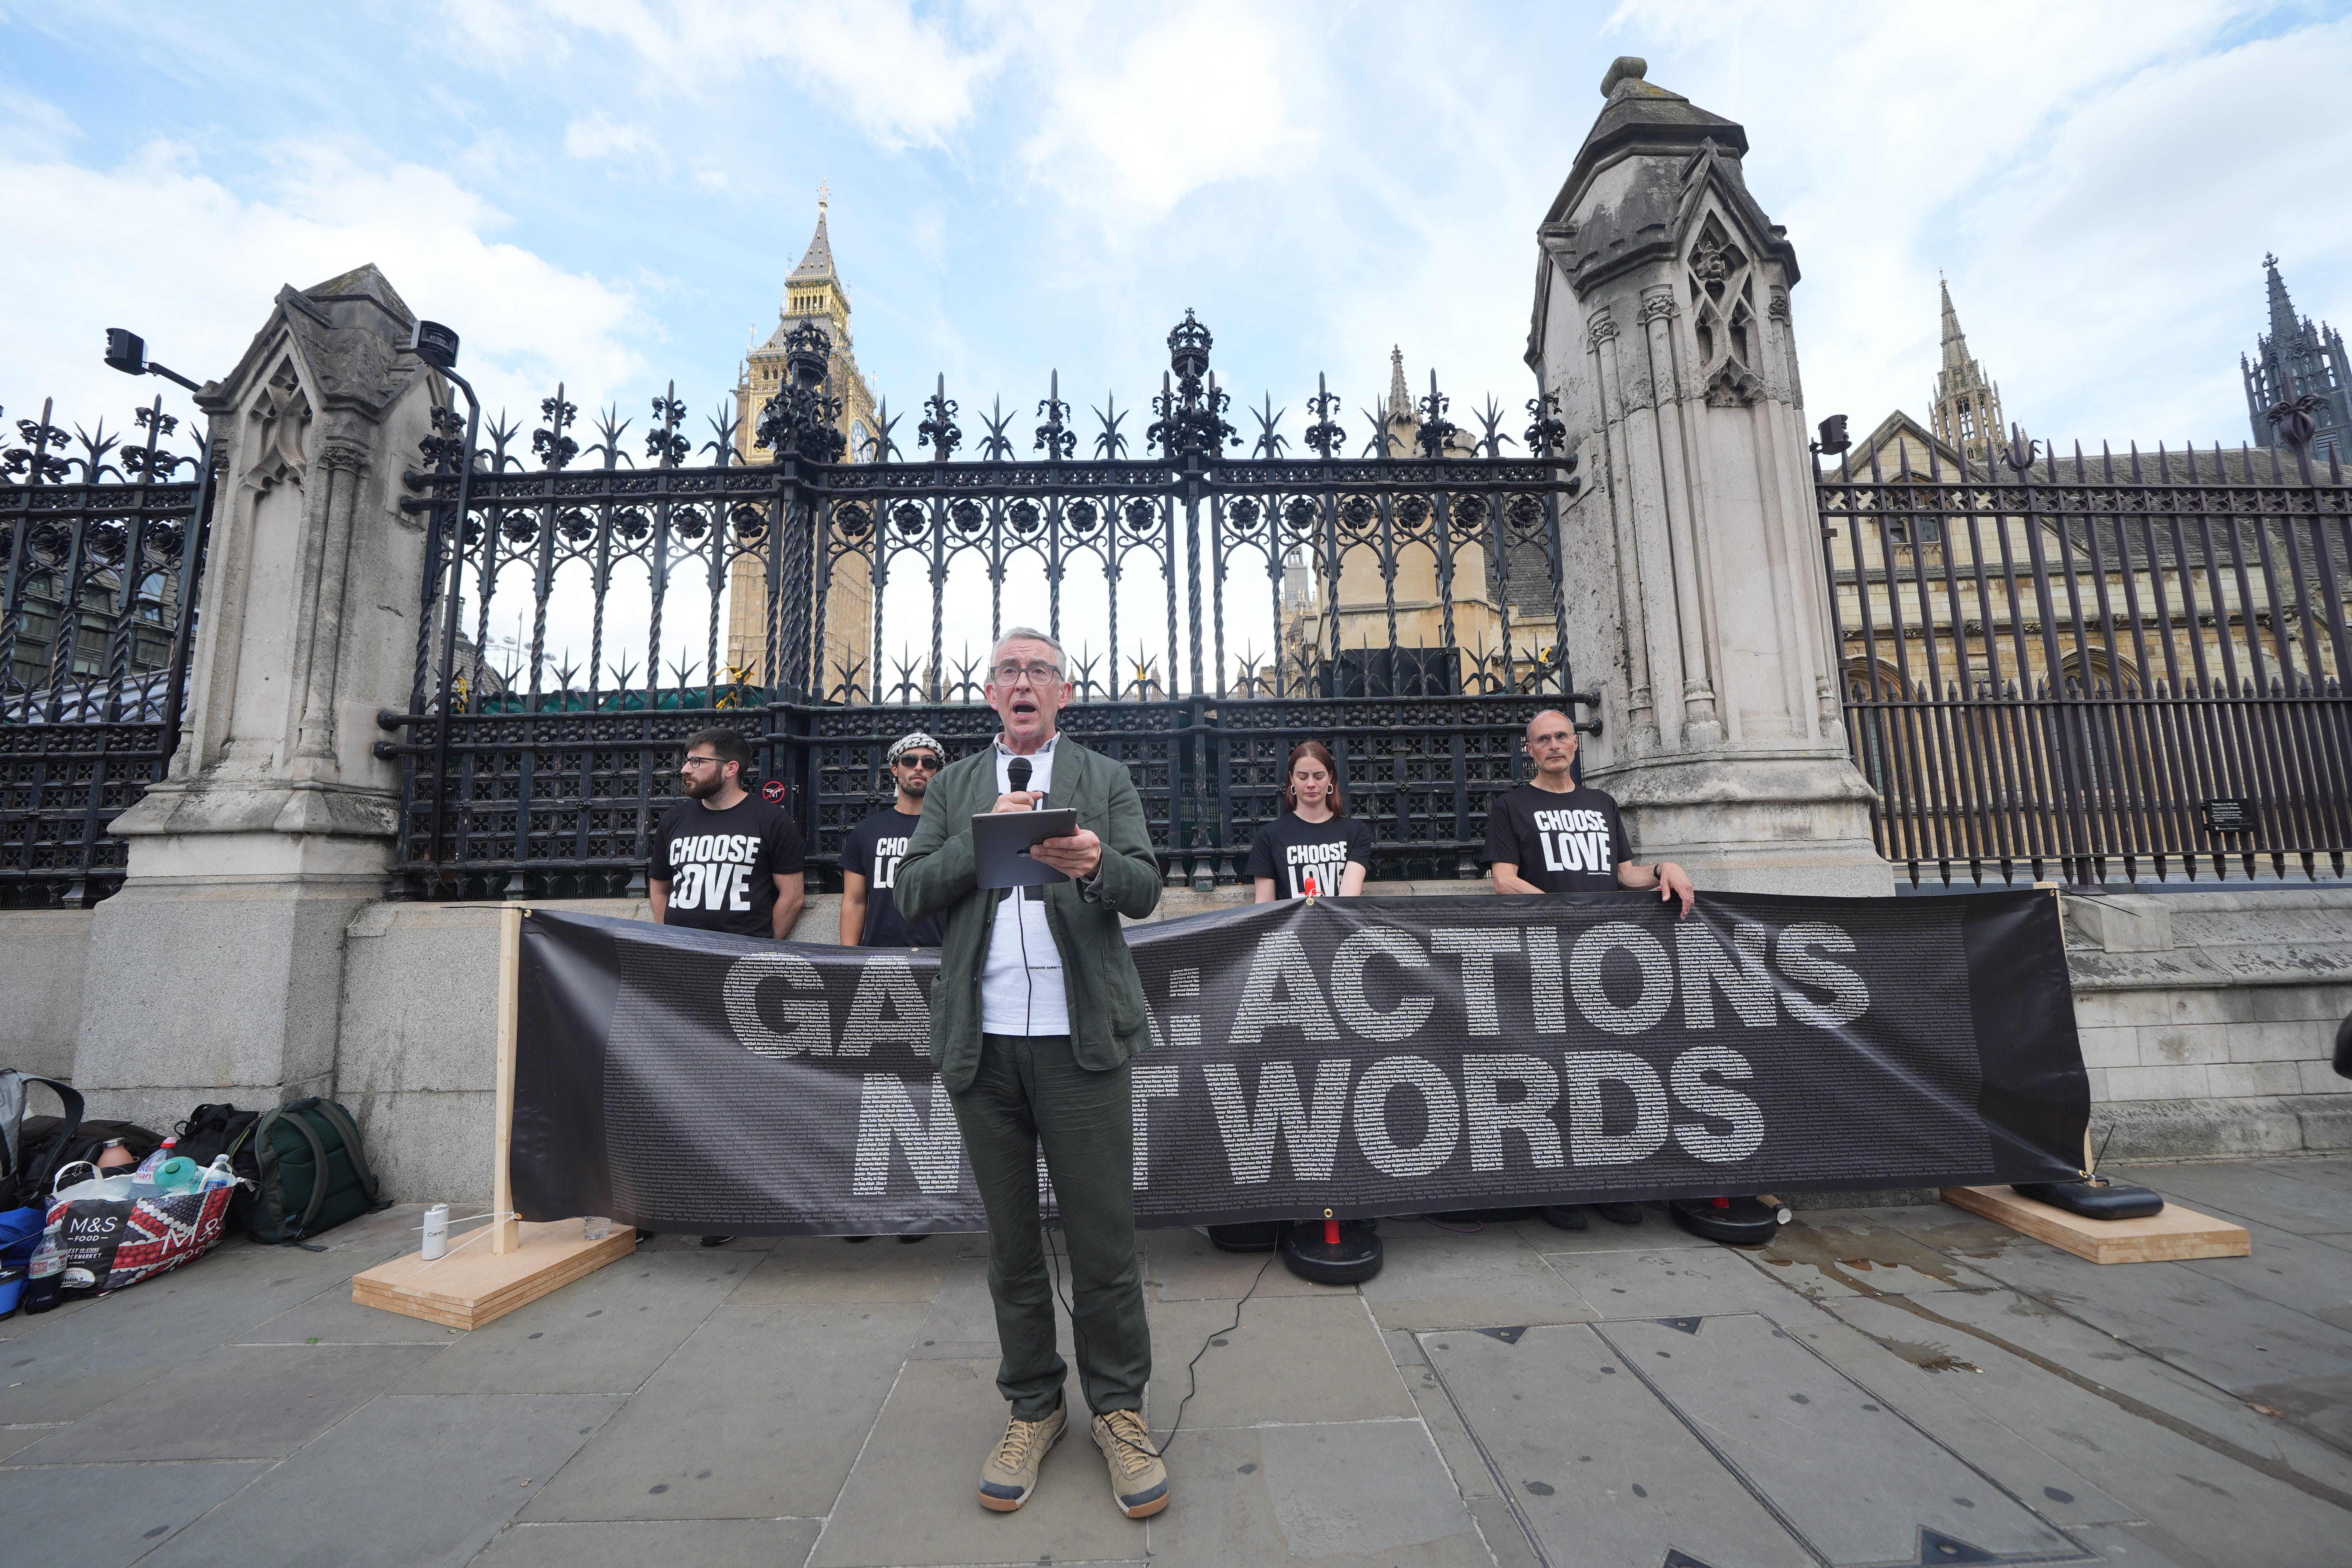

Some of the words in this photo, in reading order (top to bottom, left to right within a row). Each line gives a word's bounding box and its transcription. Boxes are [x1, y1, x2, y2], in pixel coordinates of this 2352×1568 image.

[1534, 809, 1609, 832] CHOOSE
[669, 835, 761, 866] CHOOSE
[876, 837, 911, 856] CHO
[1287, 841, 1347, 865] CHOOSE
[1540, 832, 1611, 871] LOVE
[668, 863, 753, 911] LOVE
[873, 857, 902, 888] LO
[1228, 921, 1870, 1044] ACTIONS
[1203, 1046, 1764, 1183] WORDS
[70, 1216, 118, 1233] M&S
